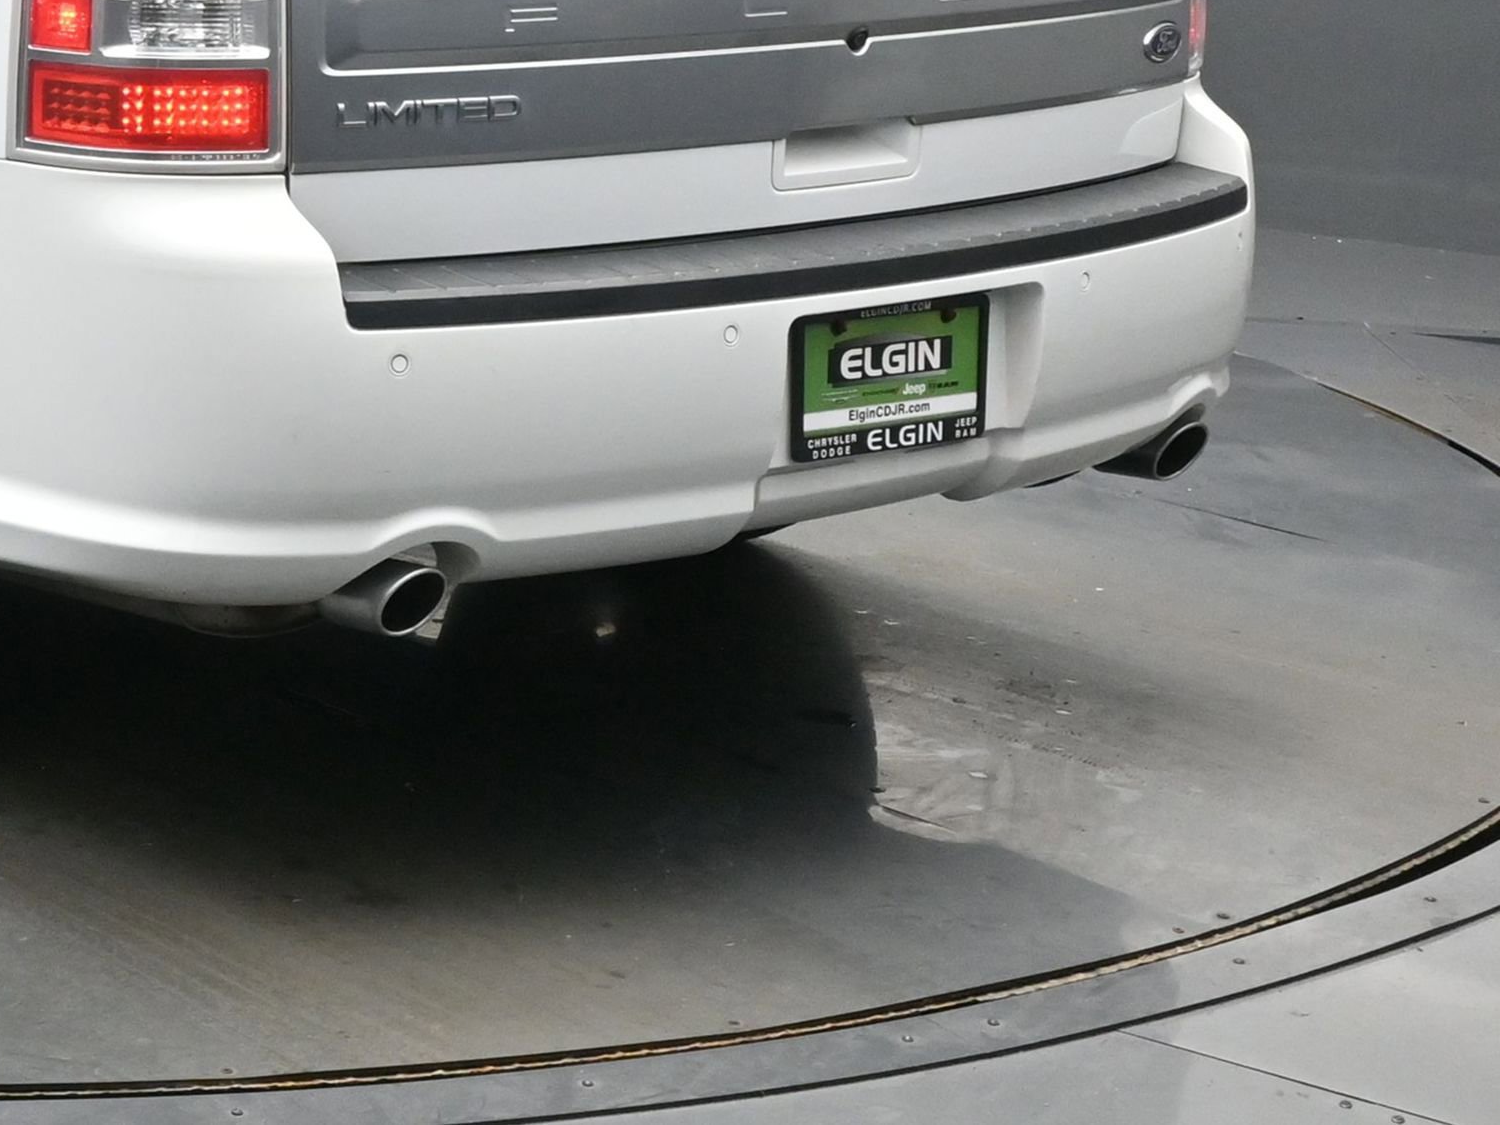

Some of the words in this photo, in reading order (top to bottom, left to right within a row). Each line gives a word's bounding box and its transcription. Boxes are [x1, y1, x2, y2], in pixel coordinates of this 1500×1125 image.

[336, 94, 522, 126] LIMITED
[840, 338, 941, 380] ELGIN
[902, 382, 926, 395] Jeep
[848, 401, 931, 422] ElginCDJR.com
[807, 433, 858, 449] CHRYSLER
[867, 421, 943, 451] ELGIN
[954, 416, 978, 428] JEEP
[812, 445, 852, 459] DODGE
[955, 428, 977, 438] RAM
